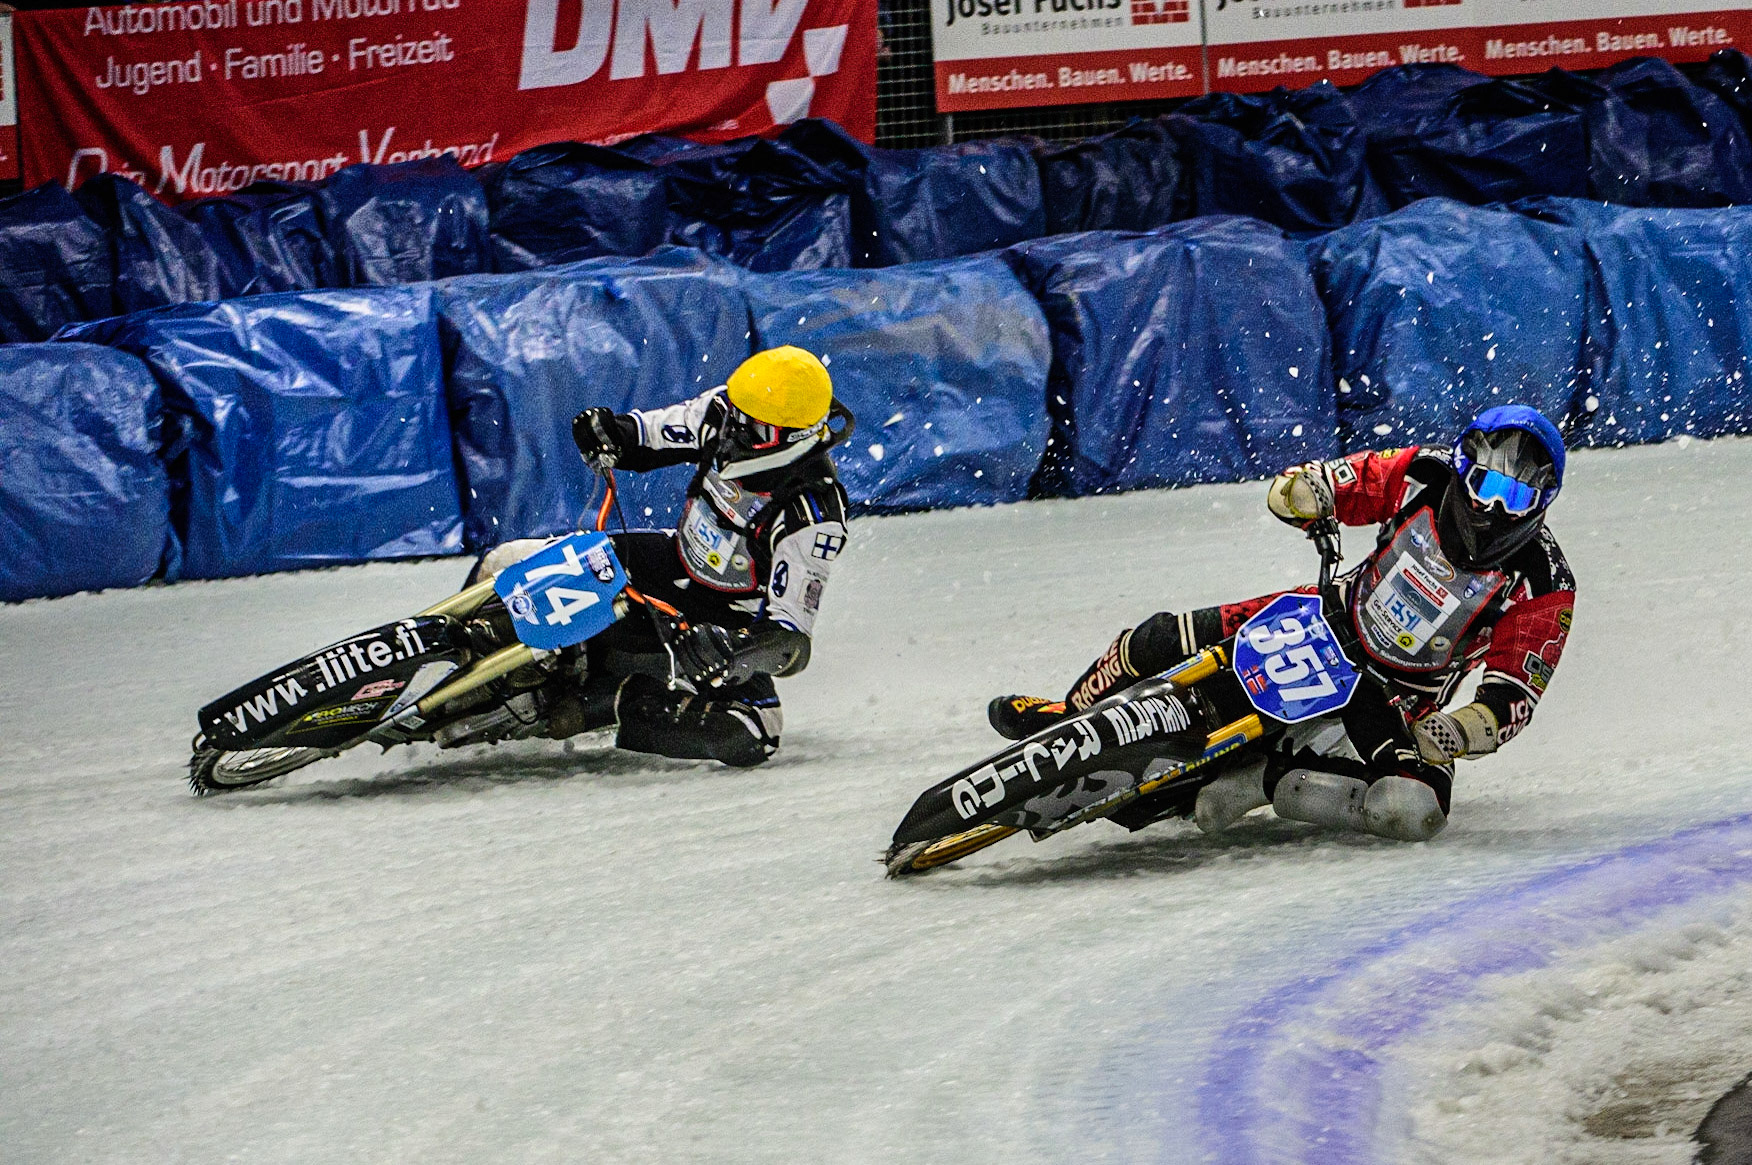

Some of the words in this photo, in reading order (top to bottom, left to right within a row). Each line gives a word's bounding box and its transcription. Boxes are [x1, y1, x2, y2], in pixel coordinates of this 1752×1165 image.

[83, 0, 238, 36] Automobil
[247, 0, 302, 27] und
[517, 0, 808, 91] DMV
[1484, 35, 1591, 61] Menschen.
[1596, 31, 1664, 53] Bauen.
[1668, 26, 1733, 48] Werte.
[96, 52, 202, 95] Jugend
[225, 45, 325, 80] Familie
[347, 31, 455, 71] Freizeit
[948, 69, 1052, 96] Menschen.
[1057, 66, 1124, 88] Bauen.
[1128, 61, 1193, 84] Werte.
[1217, 51, 1323, 79] Menschen.
[1327, 48, 1396, 71] Bauen.
[1400, 43, 1465, 65] Werte.
[153, 142, 349, 193] Motorsport
[525, 544, 600, 626] 74
[1071, 654, 1122, 713] RACING
[1249, 617, 1338, 702] 357
